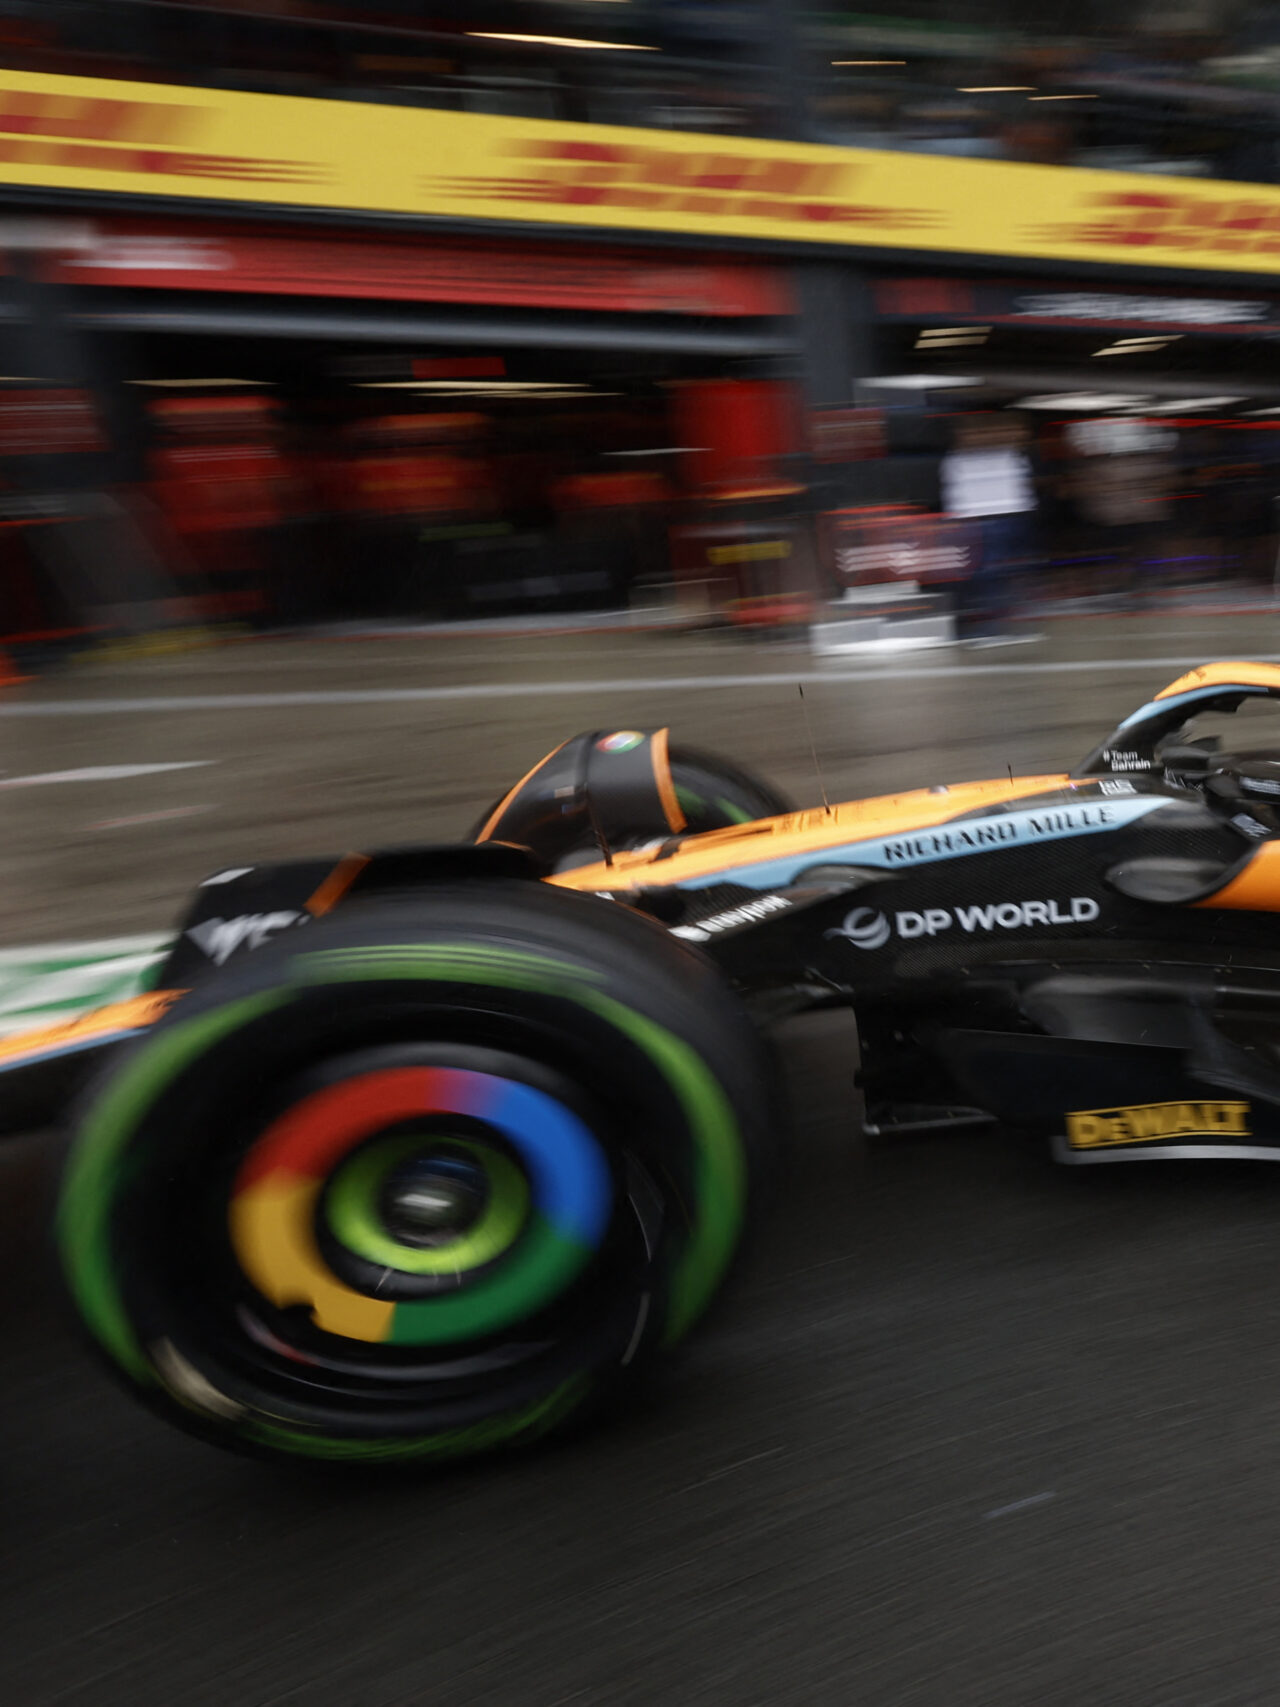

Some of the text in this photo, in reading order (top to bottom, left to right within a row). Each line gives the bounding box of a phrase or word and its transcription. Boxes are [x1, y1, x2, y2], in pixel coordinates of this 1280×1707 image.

[1111, 759, 1150, 771] Bahrain
[884, 806, 1115, 862] RICHARD MILLE
[895, 897, 1100, 938] DP WORLD
